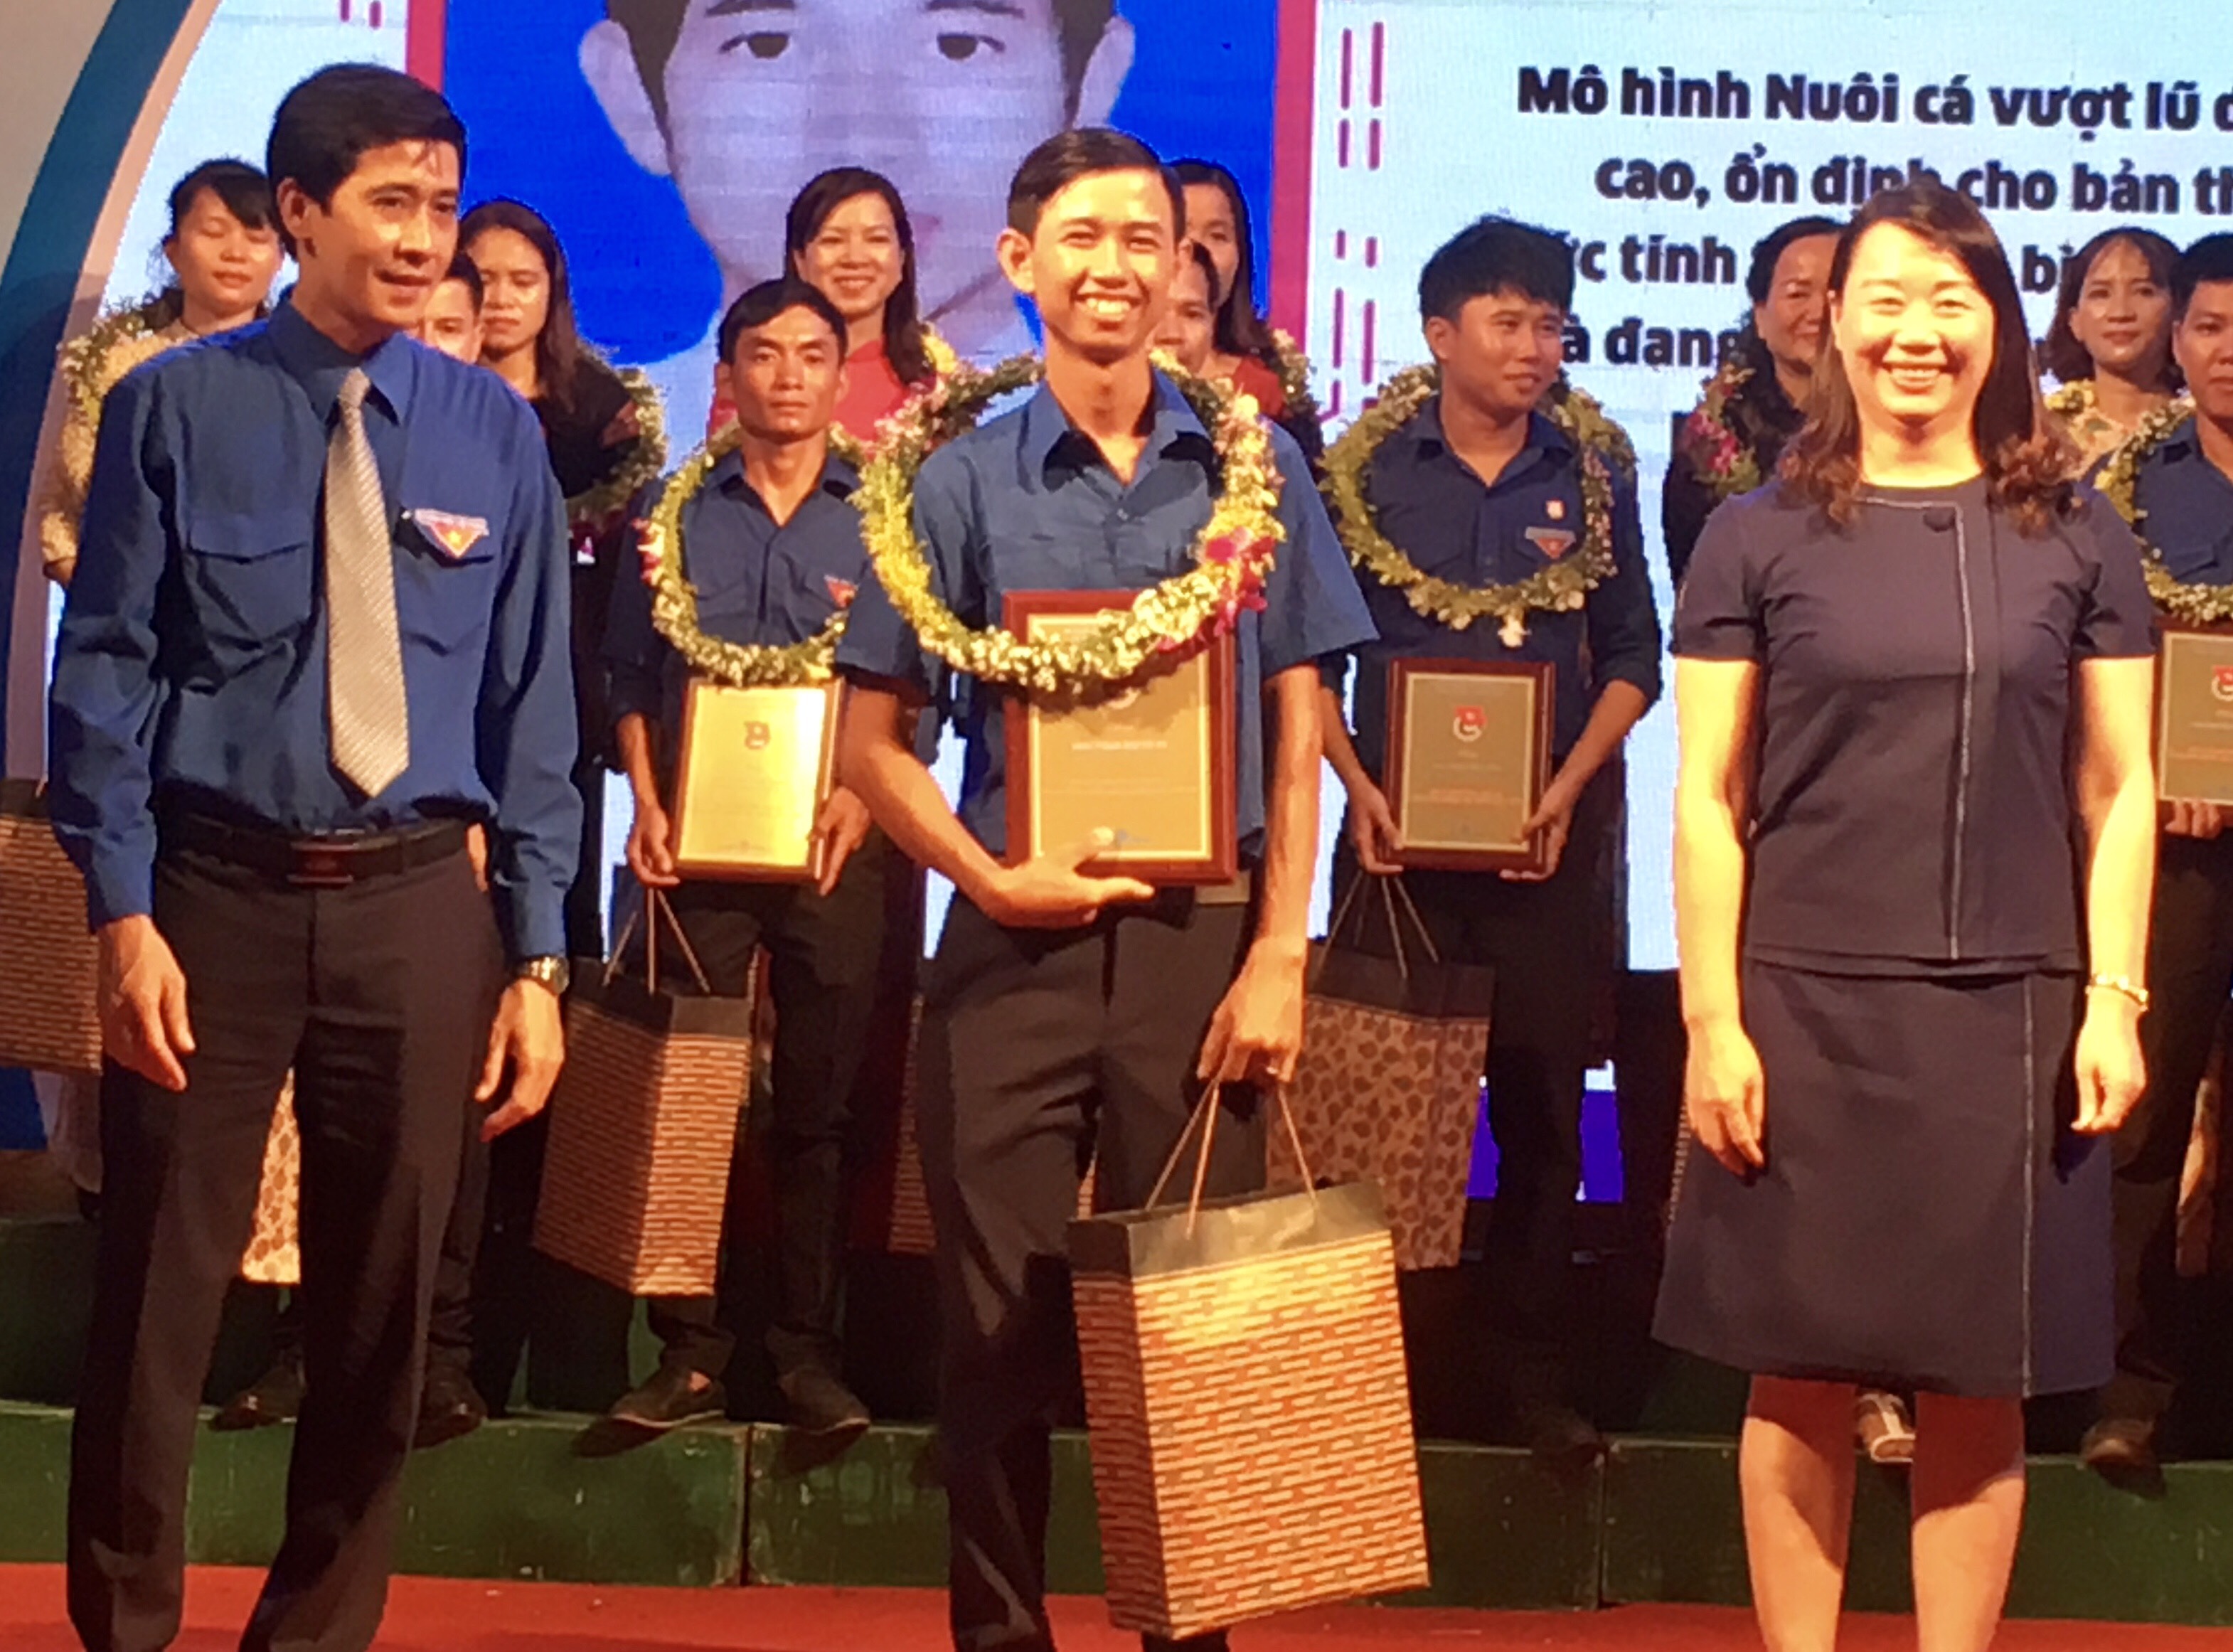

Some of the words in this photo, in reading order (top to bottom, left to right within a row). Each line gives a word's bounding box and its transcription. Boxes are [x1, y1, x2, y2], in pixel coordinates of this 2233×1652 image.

[1518, 64, 1608, 114] Mô
[1621, 66, 1750, 119] hình
[1765, 72, 1899, 122] Nuôi
[1913, 74, 1974, 124] cá
[1988, 82, 2133, 142] vượt
[2146, 80, 2200, 130] lũ
[1595, 157, 1710, 208] cao,
[1725, 142, 1798, 203] ổn
[1956, 159, 2057, 211] cho
[2072, 158, 2180, 214] bản
[1620, 234, 1737, 284] tính
